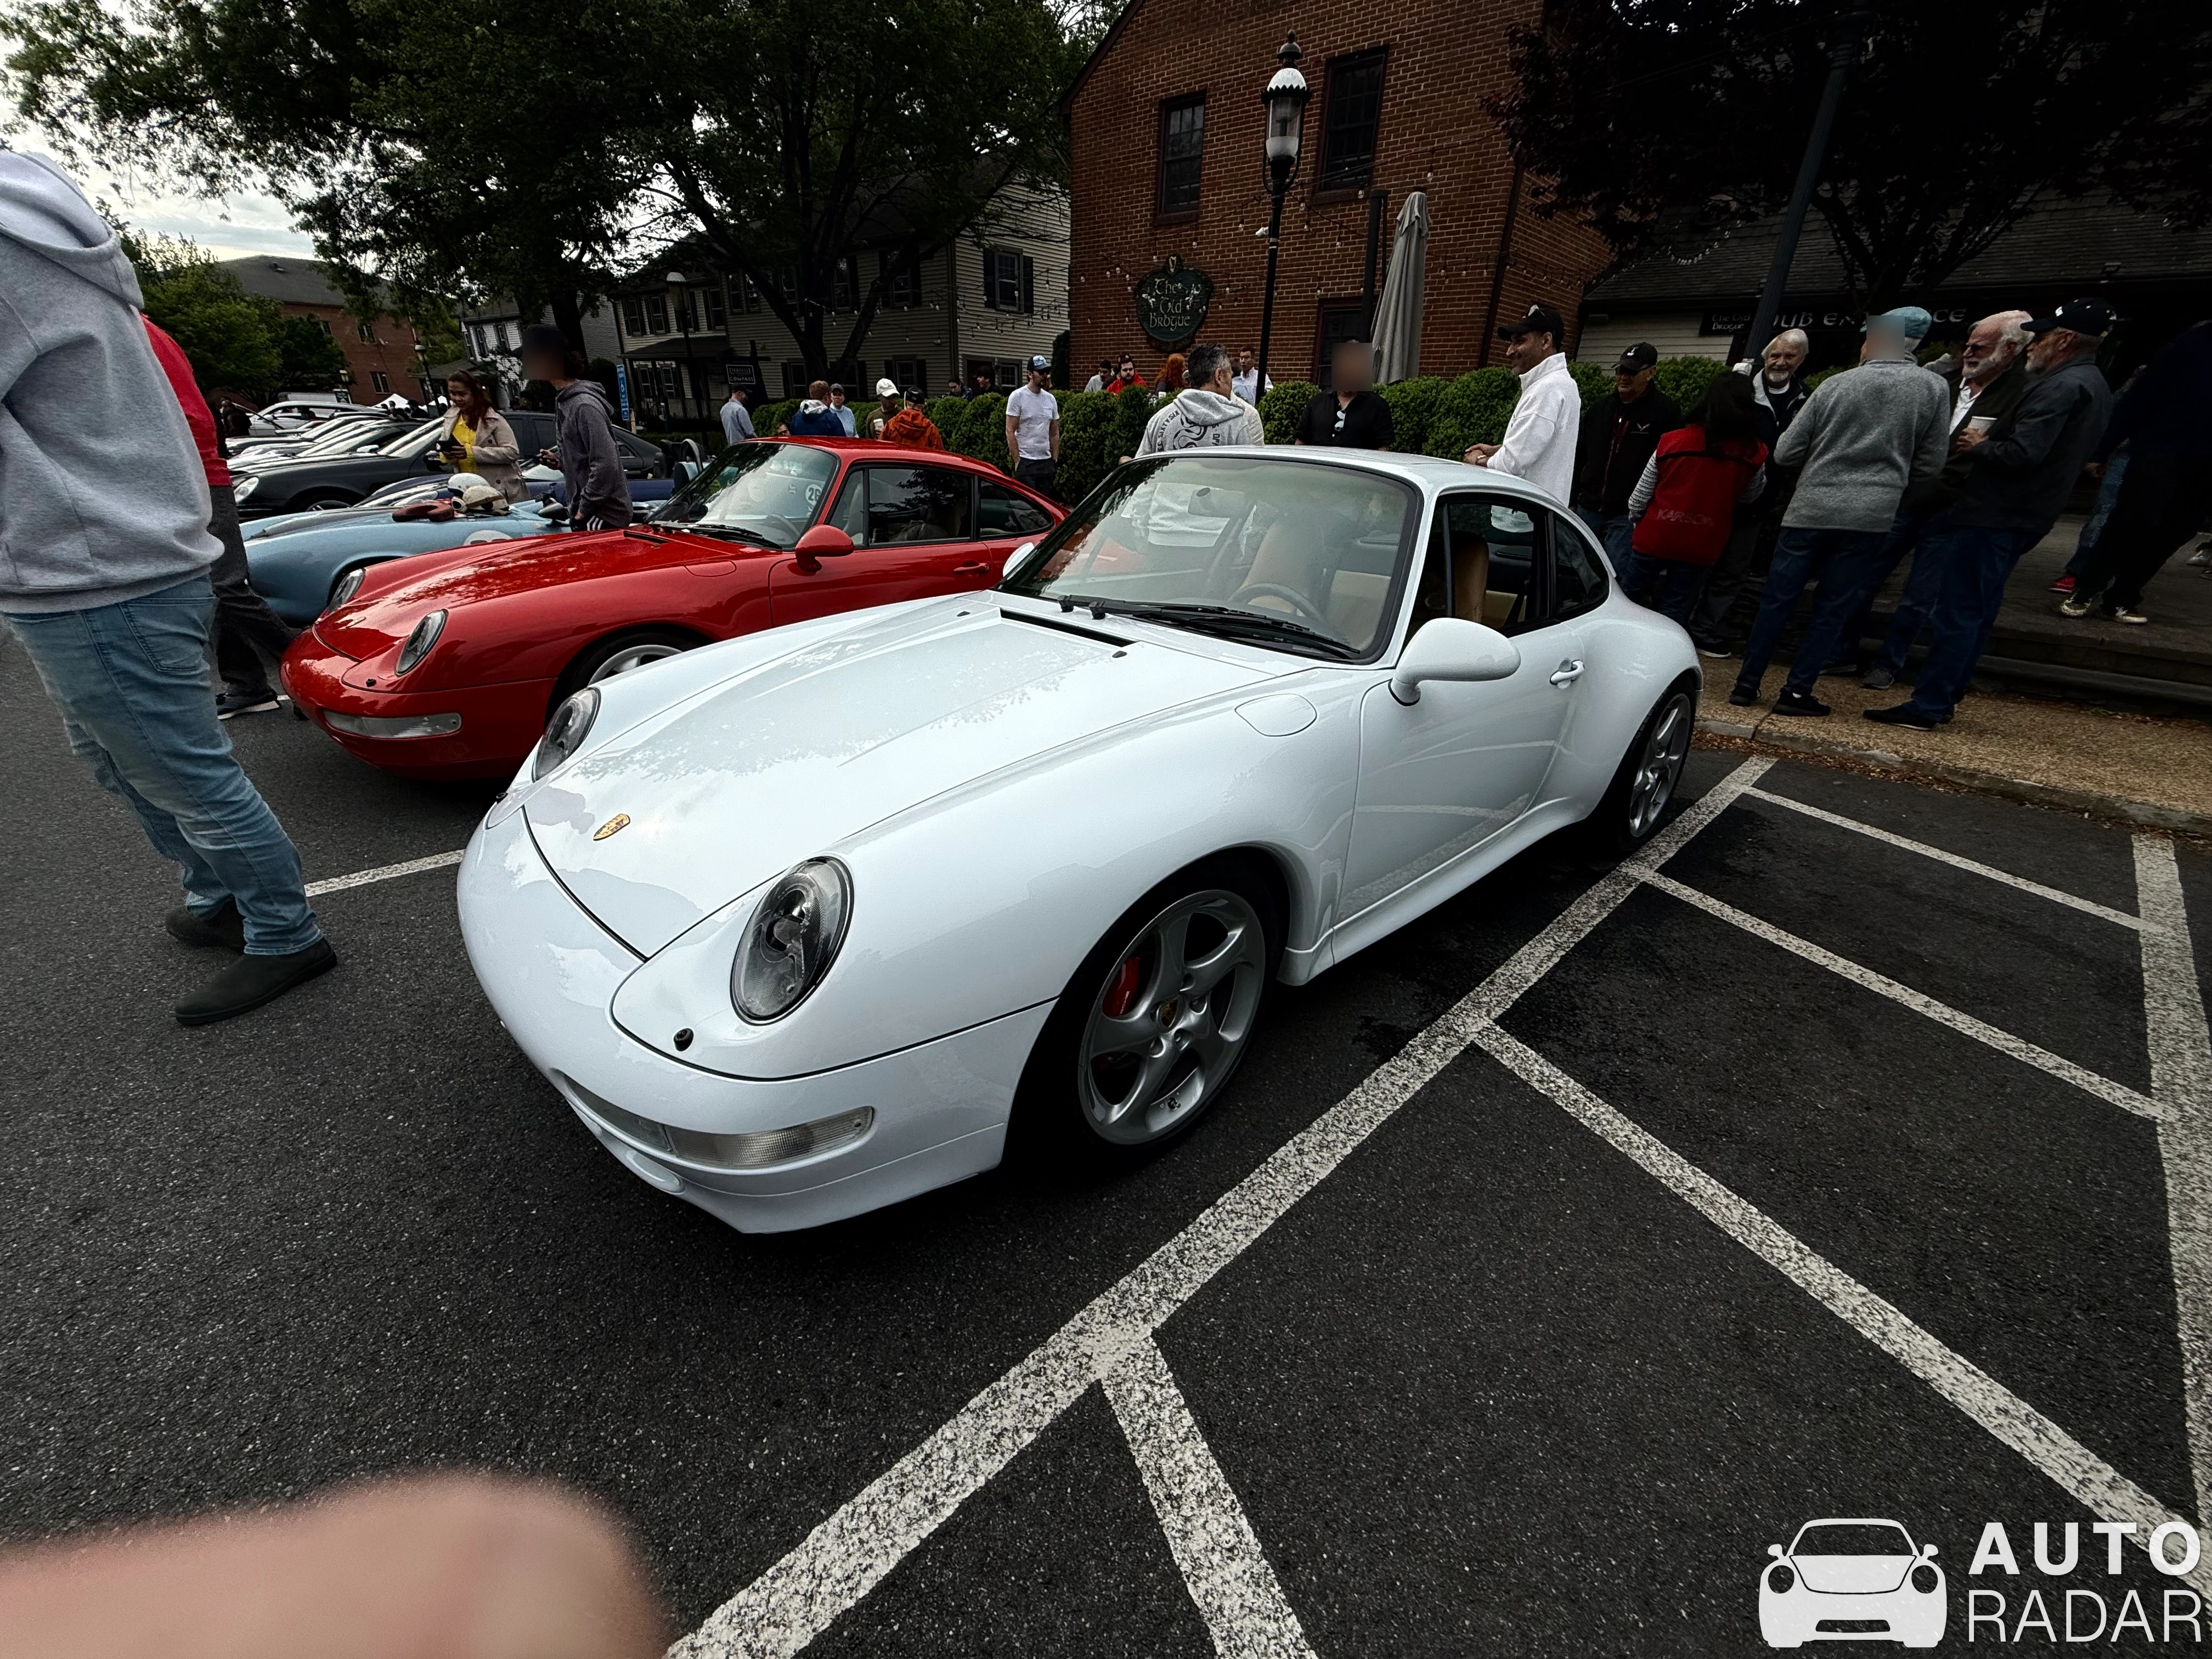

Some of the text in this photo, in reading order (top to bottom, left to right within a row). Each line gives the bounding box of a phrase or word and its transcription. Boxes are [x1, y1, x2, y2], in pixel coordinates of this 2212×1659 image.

[1154, 278, 1178, 295] The
[1160, 296, 1182, 314] Old
[1150, 312, 1190, 331] Brogue
[1712, 312, 1751, 322] The Old
